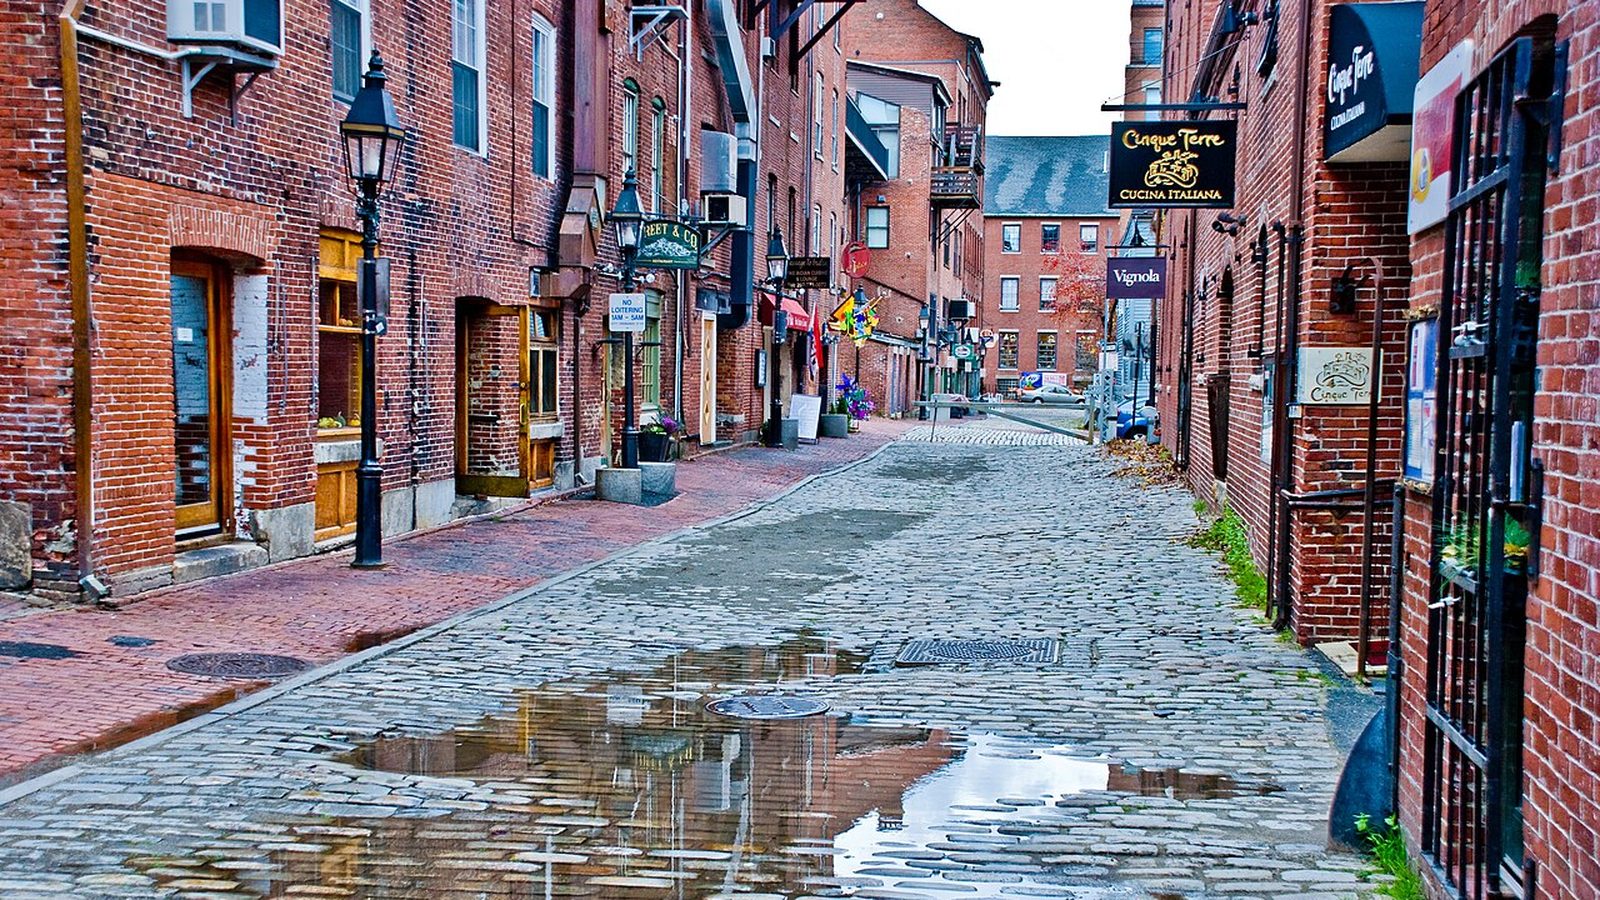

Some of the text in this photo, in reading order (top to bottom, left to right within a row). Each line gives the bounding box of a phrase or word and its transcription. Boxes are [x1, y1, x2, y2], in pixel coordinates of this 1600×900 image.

[1122, 128, 1225, 152] Cinque Terre
[1120, 189, 1222, 199] CUCINA ITALIANA
[644, 223, 668, 238] REET
[672, 225, 680, 238] &
[1113, 268, 1160, 287] Vignola
[611, 306, 643, 314] LOITERING
[1311, 387, 1371, 402] Cinque Ter
